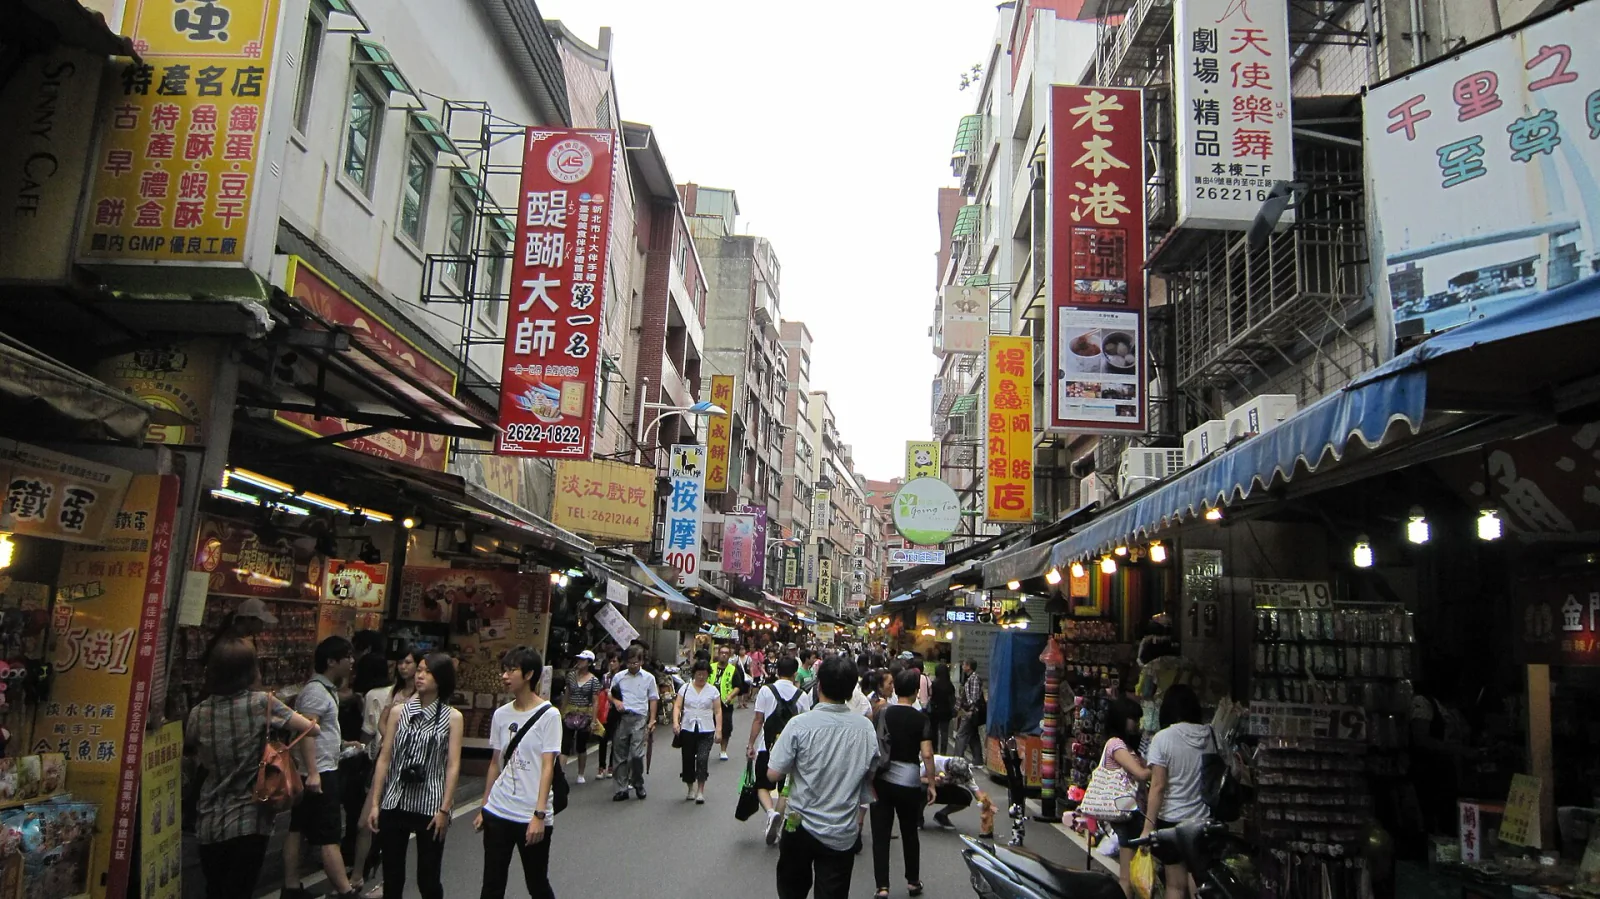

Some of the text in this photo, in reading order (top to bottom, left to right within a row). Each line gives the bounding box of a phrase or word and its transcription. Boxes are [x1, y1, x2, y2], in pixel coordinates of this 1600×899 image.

[122, 64, 265, 97] 特產名店
[1229, 28, 1274, 161] 天使樂舞
[95, 104, 142, 227] 古早餅
[1068, 89, 1131, 225] 老本港
[1211, 163, 1272, 177] 本棟二F
[15, 152, 58, 217] CAFE
[129, 236, 165, 252] GMP
[515, 190, 568, 357] 醍醐大師
[565, 283, 595, 358] 第一名
[507, 423, 580, 443] 2622-1822
[988, 412, 1007, 478] 魚丸湯
[1012, 413, 1031, 481] 阿給
[9, 478, 96, 532] 鐵蛋
[561, 475, 648, 508] 淡江戲院
[994, 482, 1026, 511] 店
[668, 479, 698, 550] 按摩
[666, 552, 696, 575] 100
[1300, 584, 1331, 608] 19
[946, 611, 975, 622] 雨傘王
[1188, 603, 1218, 638] 19
[56, 628, 133, 673] 5送1
[46, 703, 117, 719] 淡水名產
[1329, 709, 1367, 740] 19
